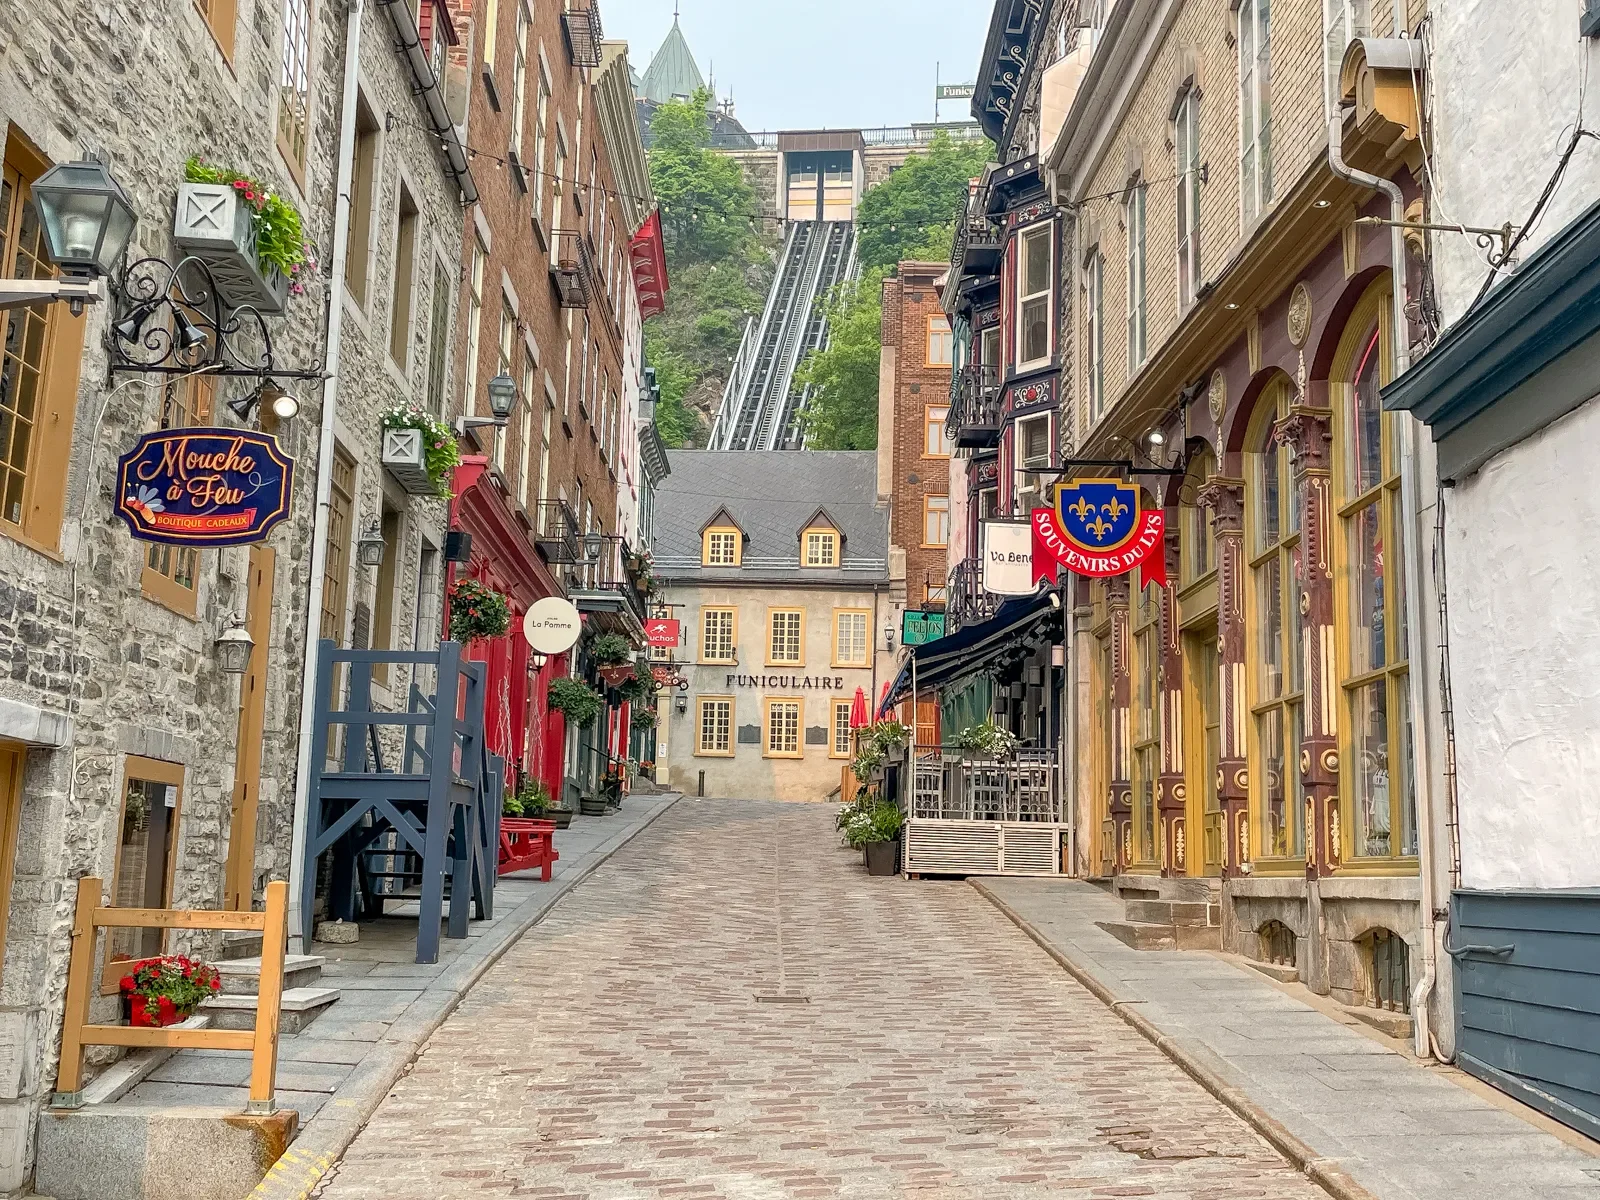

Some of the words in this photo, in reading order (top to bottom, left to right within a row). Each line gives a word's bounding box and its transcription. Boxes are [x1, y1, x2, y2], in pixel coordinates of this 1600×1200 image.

[137, 436, 255, 481] Mouche
[166, 478, 184, 500] à
[187, 474, 245, 508] Feu
[157, 516, 202, 528] BOUTIQUE
[206, 516, 247, 528] CADEAUX
[1035, 512, 1120, 572] SOUVENIRS
[1122, 545, 1144, 566] DU
[1139, 514, 1162, 548] LYS
[990, 551, 1005, 562] Va
[532, 620, 542, 628] La
[544, 620, 572, 629] Pomme
[726, 674, 843, 690] FUNICULAIRE
